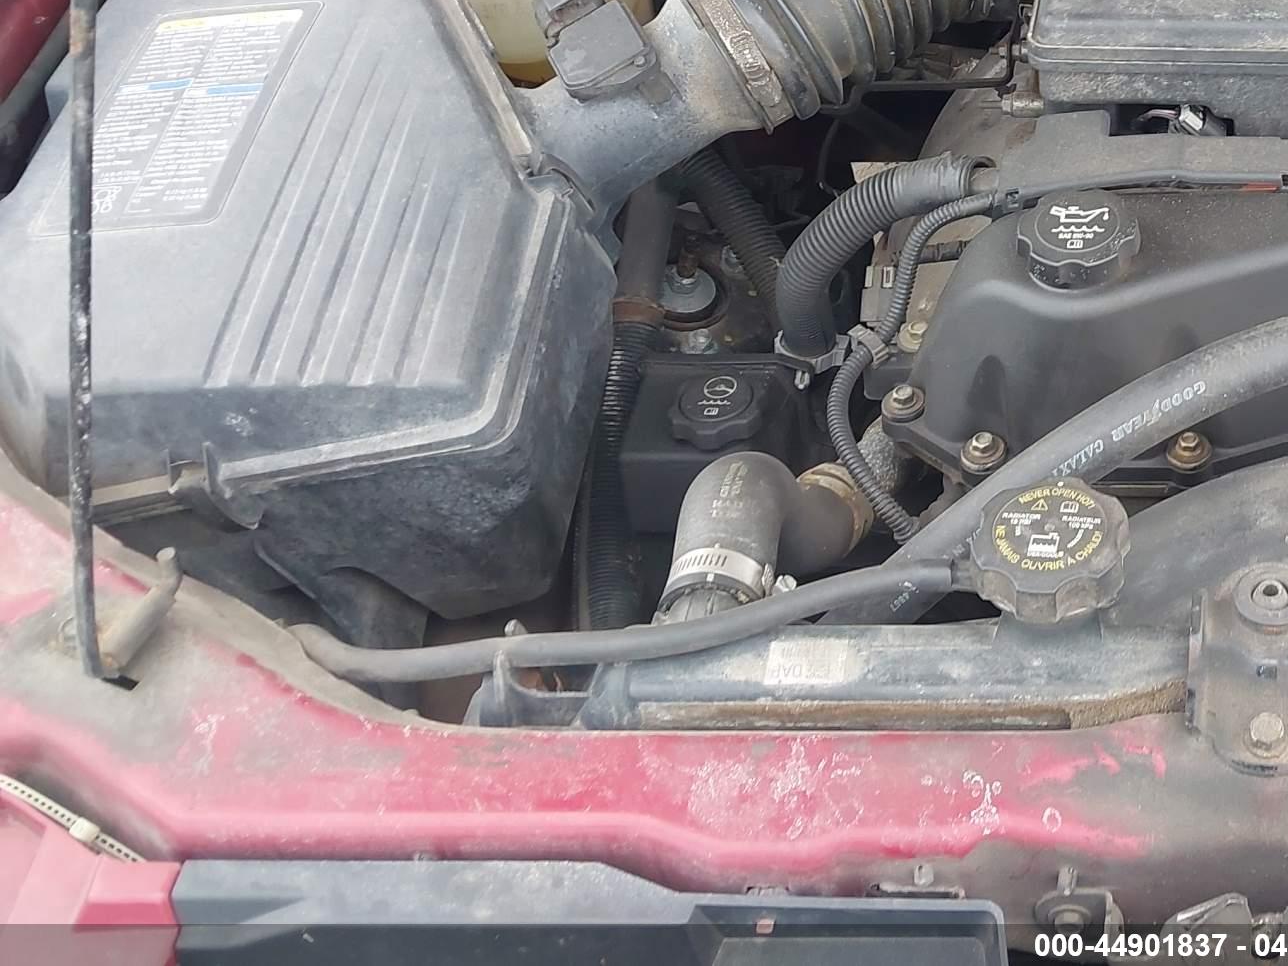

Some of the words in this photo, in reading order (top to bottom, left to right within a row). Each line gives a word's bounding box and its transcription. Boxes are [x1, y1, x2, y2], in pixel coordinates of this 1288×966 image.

[1111, 380, 1207, 442] GOODYEAR
[1018, 488, 1051, 505] NEVER
[1051, 488, 1078, 500] OPEN
[1002, 512, 1041, 520] RADIATOR
[1062, 515, 1102, 524] RADIATEUR
[996, 539, 1021, 564] JAMAIS
[1021, 558, 1065, 571] OUVRIR
